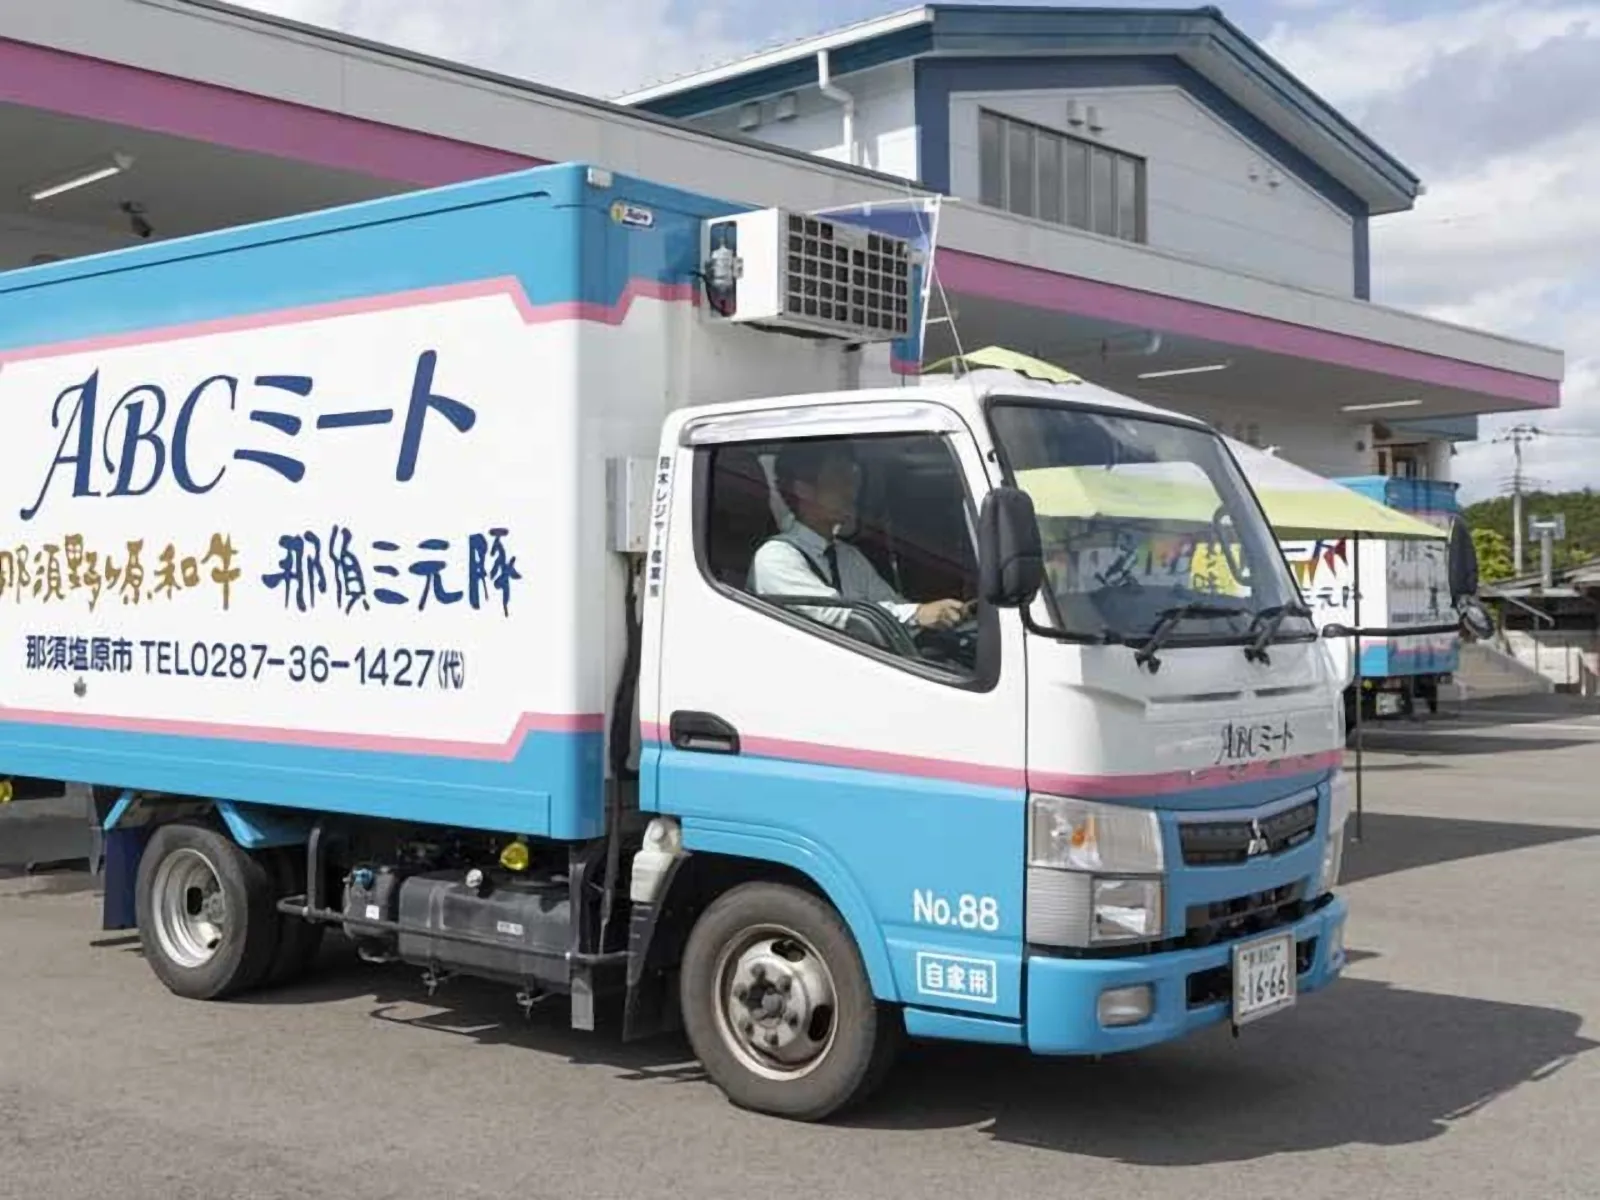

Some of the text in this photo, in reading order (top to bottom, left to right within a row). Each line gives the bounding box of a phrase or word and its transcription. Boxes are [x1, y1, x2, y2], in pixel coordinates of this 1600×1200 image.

[20, 350, 477, 521] ABCミート
[26, 635, 133, 672] 那須塩原市
[1215, 719, 1294, 765] ABCミート
[913, 888, 999, 931] No.88
[925, 962, 989, 995] 自家用
